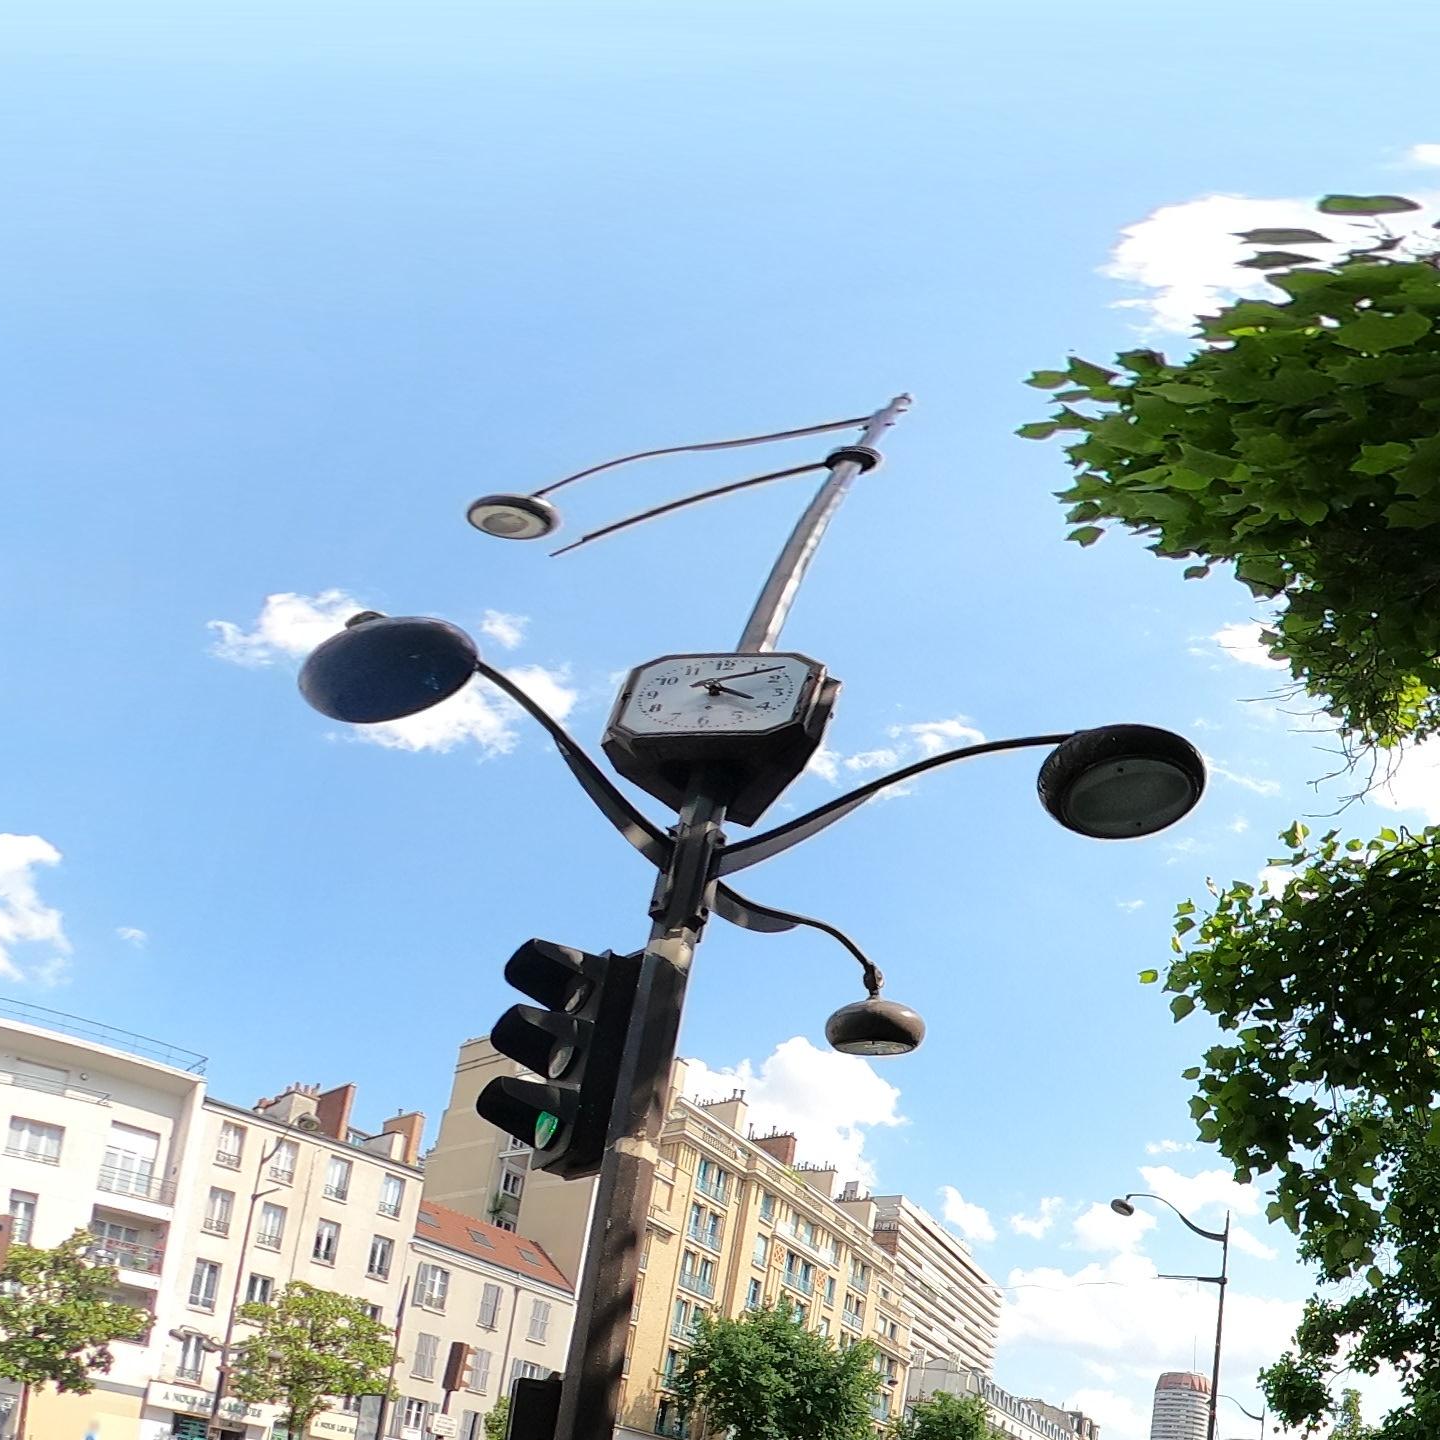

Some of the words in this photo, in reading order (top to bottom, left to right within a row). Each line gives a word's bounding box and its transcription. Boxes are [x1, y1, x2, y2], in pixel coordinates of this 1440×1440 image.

[715, 661, 736, 671] 12
[684, 667, 699, 676] 11
[656, 676, 679, 686] 10
[768, 675, 781, 683] 2
[647, 690, 659, 700] 9
[771, 688, 784, 697] 3
[649, 704, 662, 713] 8
[756, 702, 770, 711] 4
[668, 712, 682, 722] 7
[697, 715, 709, 725] 6
[731, 712, 743, 721] 5
